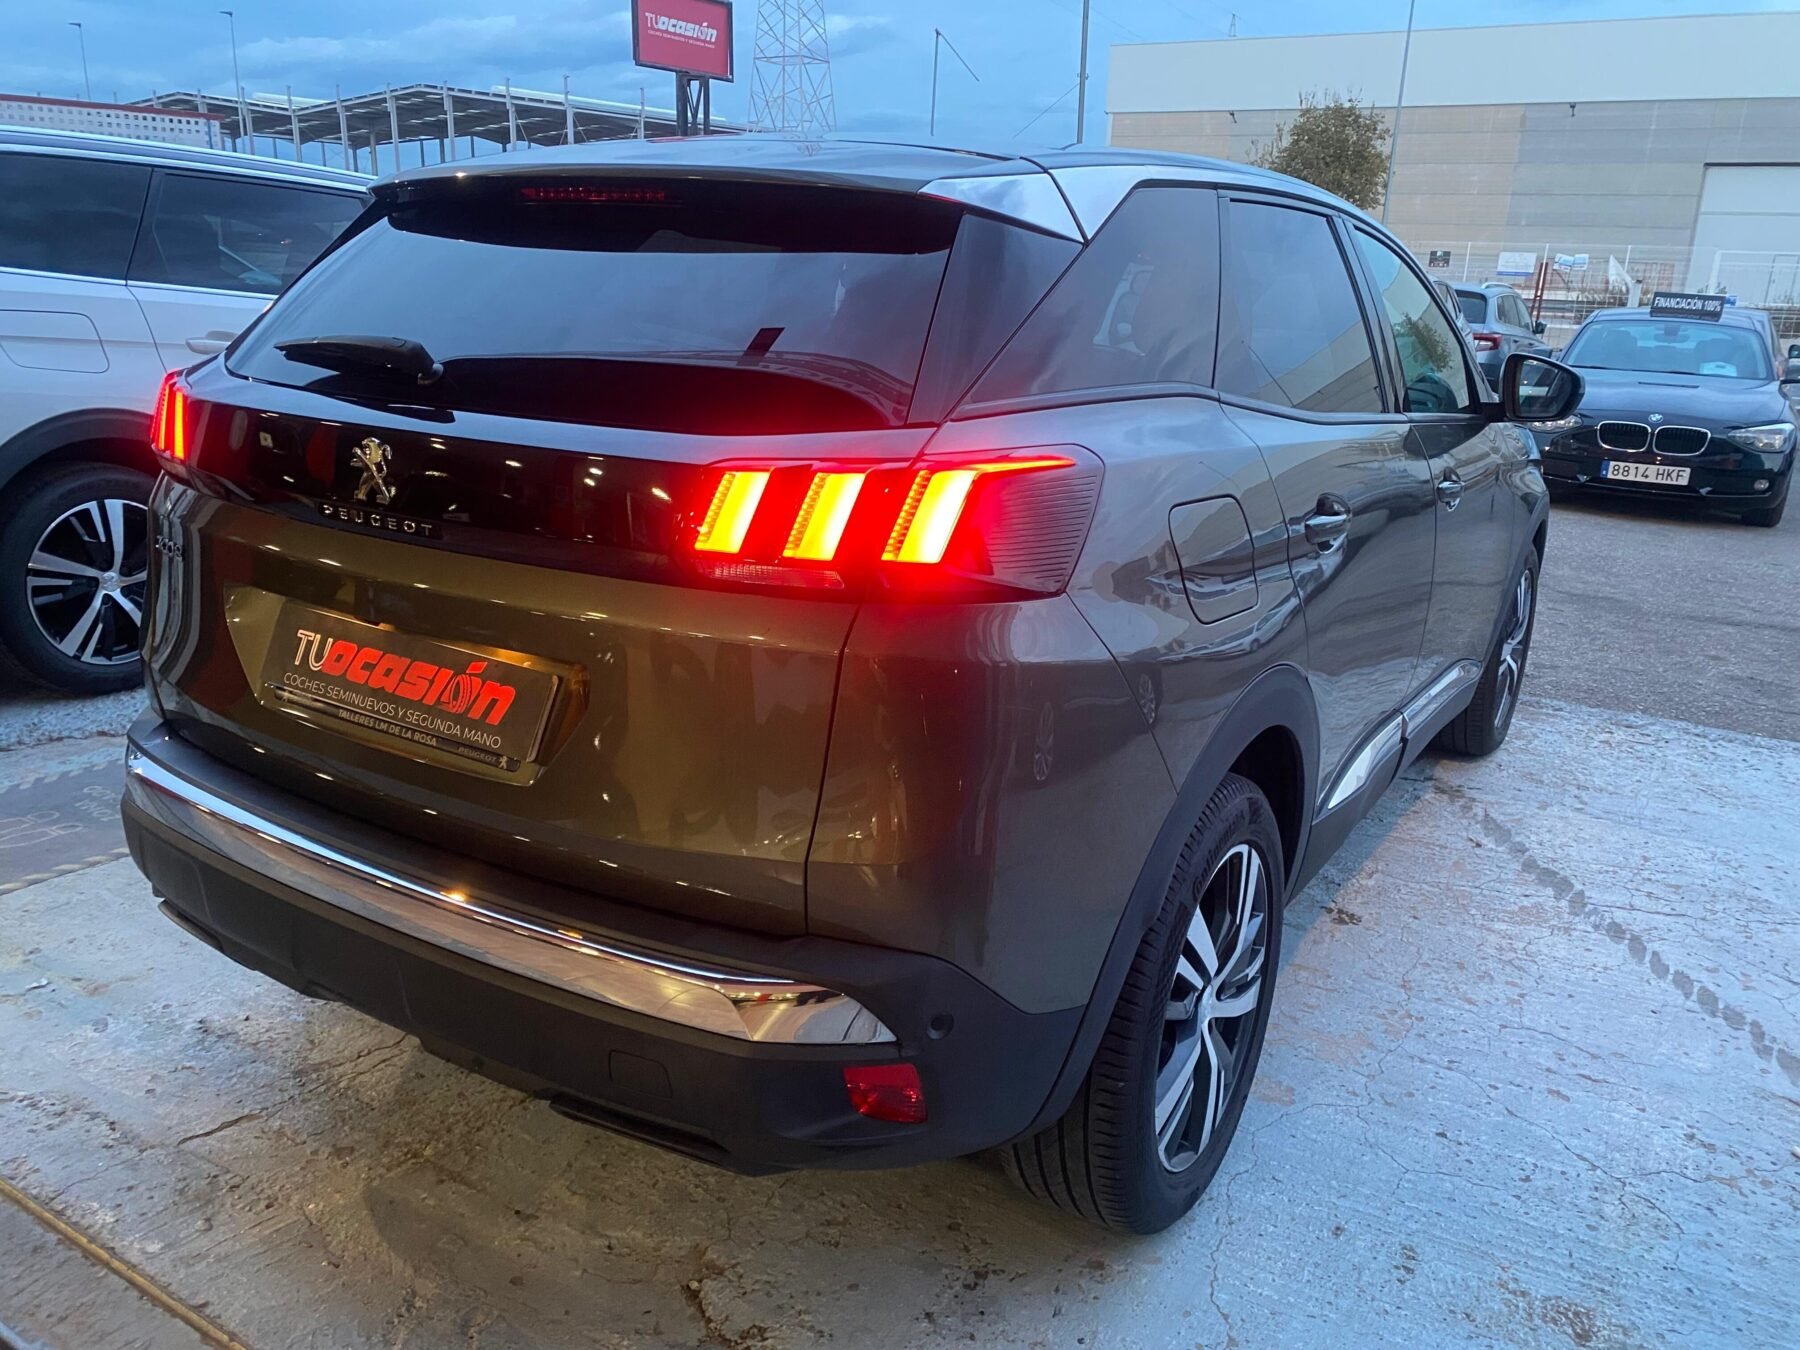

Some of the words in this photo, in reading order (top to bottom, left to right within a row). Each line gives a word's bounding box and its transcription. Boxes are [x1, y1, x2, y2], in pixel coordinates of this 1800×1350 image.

[1653, 296, 1703, 310] FINANCIACIÓN
[1704, 300, 1722, 312] 100%
[1611, 464, 1650, 479] 8814
[1656, 467, 1687, 483] HKF
[322, 504, 433, 536] PEUGEOT
[283, 672, 325, 694] COCHES
[326, 685, 395, 716] SEMINUEVOS
[398, 706, 407, 718] Y
[406, 709, 461, 738] SEGUNDA
[463, 727, 501, 749] MANO
[338, 709, 374, 728] TALLERES
[375, 720, 388, 732] LM
[389, 724, 400, 736] DE
[401, 728, 412, 740] LA
[413, 732, 438, 746] ROSA
